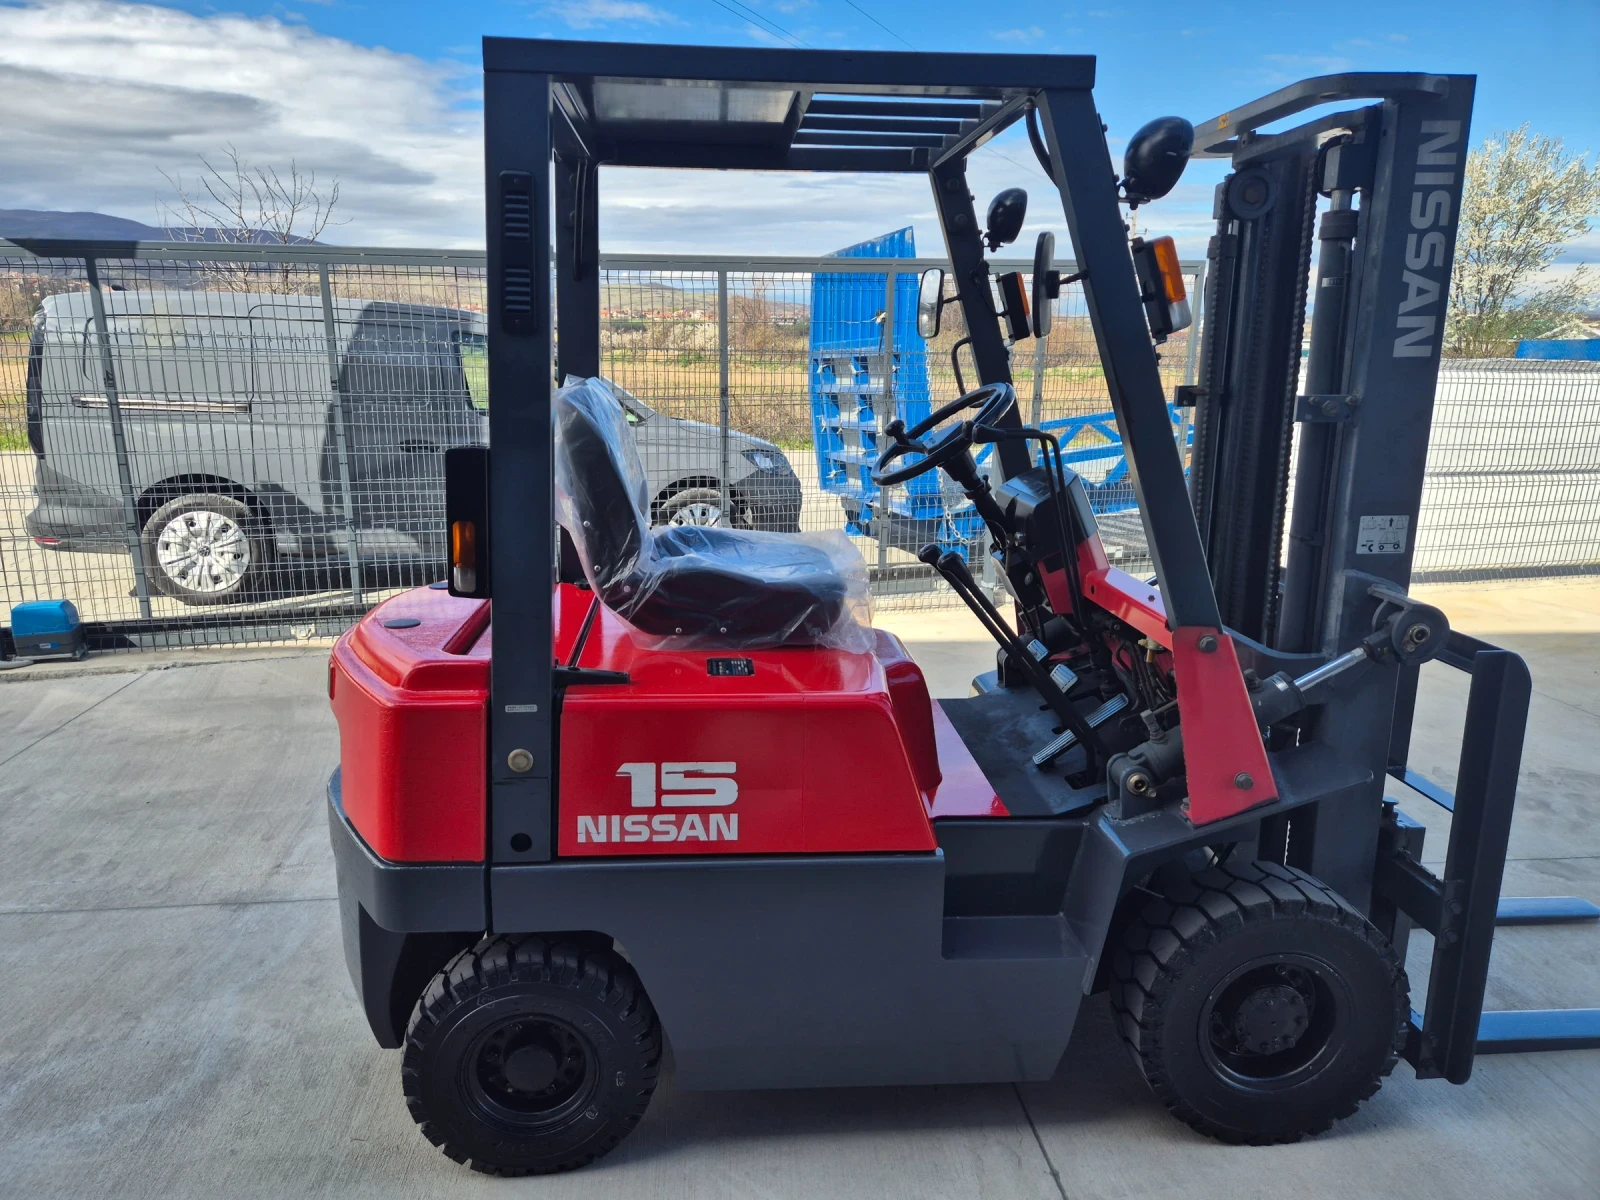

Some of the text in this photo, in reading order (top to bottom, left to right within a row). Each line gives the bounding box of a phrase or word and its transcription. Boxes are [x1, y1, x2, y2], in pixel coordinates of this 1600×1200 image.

[1393, 120, 1461, 357] NISSAN
[616, 761, 738, 807] 15
[577, 813, 738, 843] NISSAN
